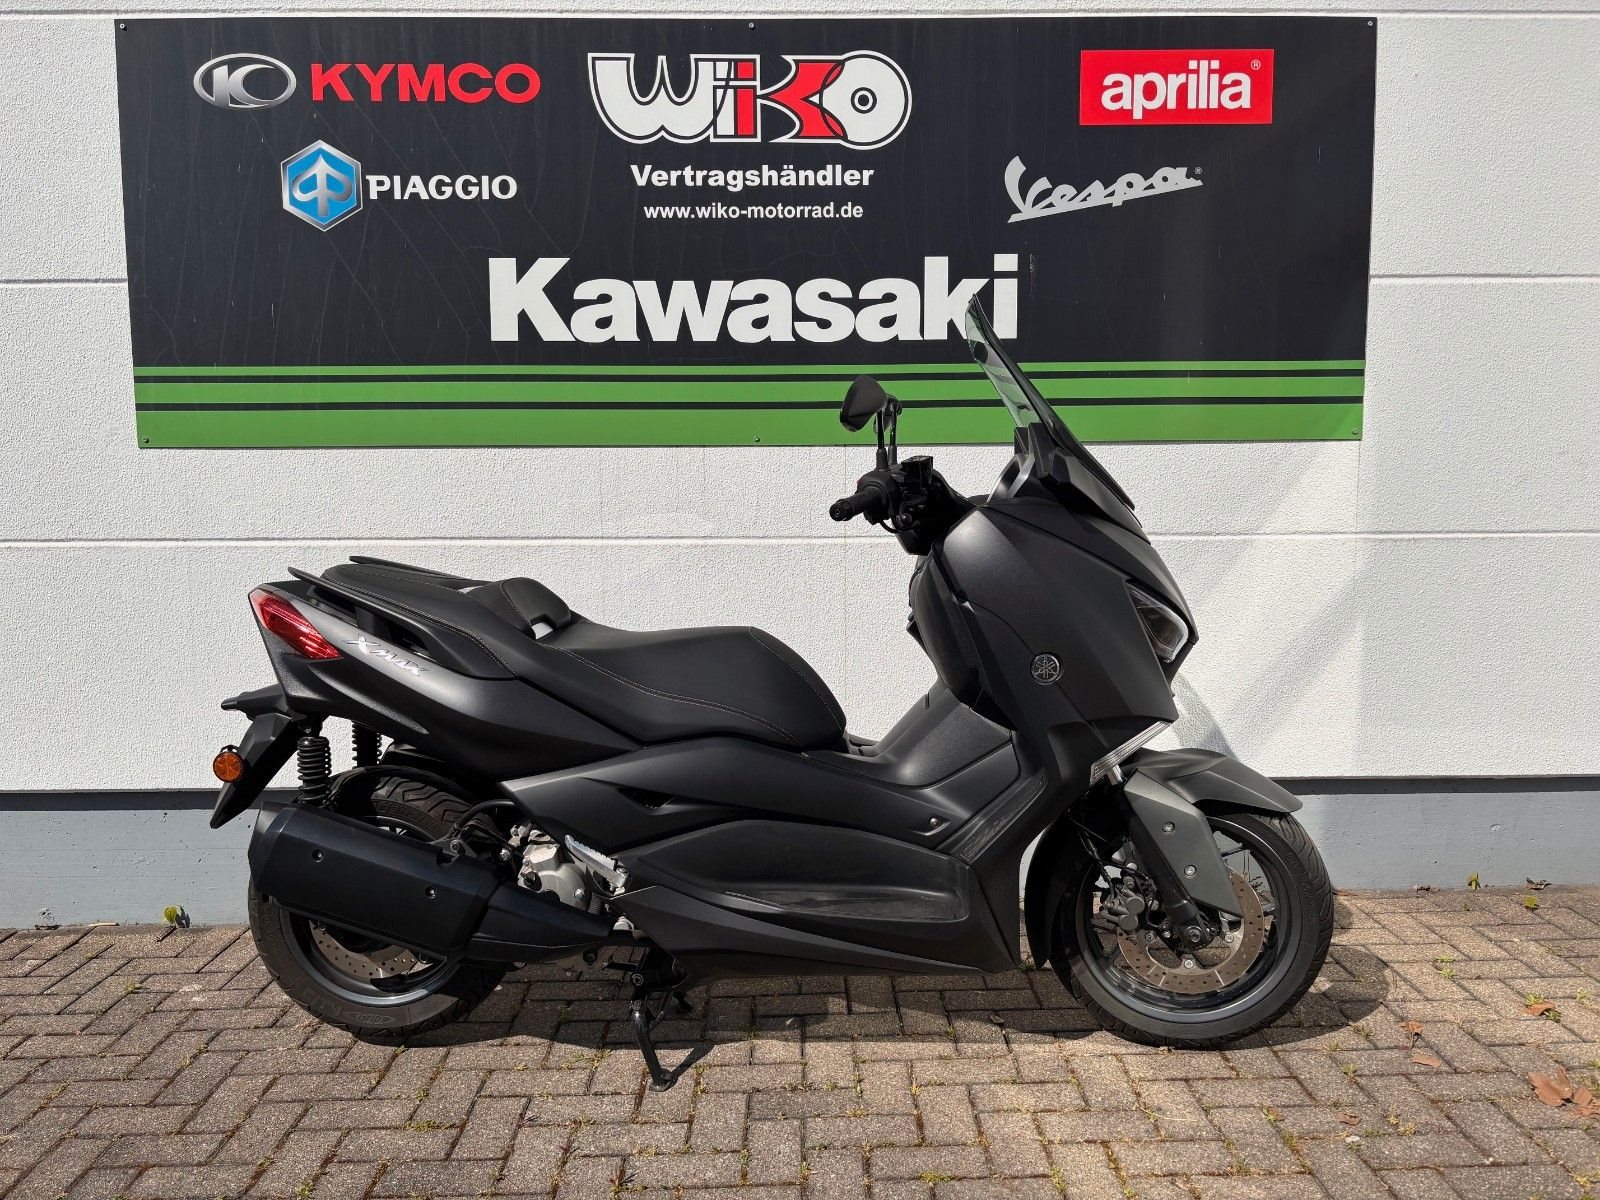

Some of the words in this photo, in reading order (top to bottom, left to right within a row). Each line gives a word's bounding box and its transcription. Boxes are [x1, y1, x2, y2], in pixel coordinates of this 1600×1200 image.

[311, 62, 541, 104] KYMCO
[1101, 60, 1251, 120] aprilia
[366, 174, 518, 201] PIAGGIO
[630, 164, 875, 192] Vertragshändler
[1004, 155, 1203, 224] Vespa
[643, 202, 864, 219] www.wiko-motorrad.de
[488, 253, 1019, 344] Kawasaki
